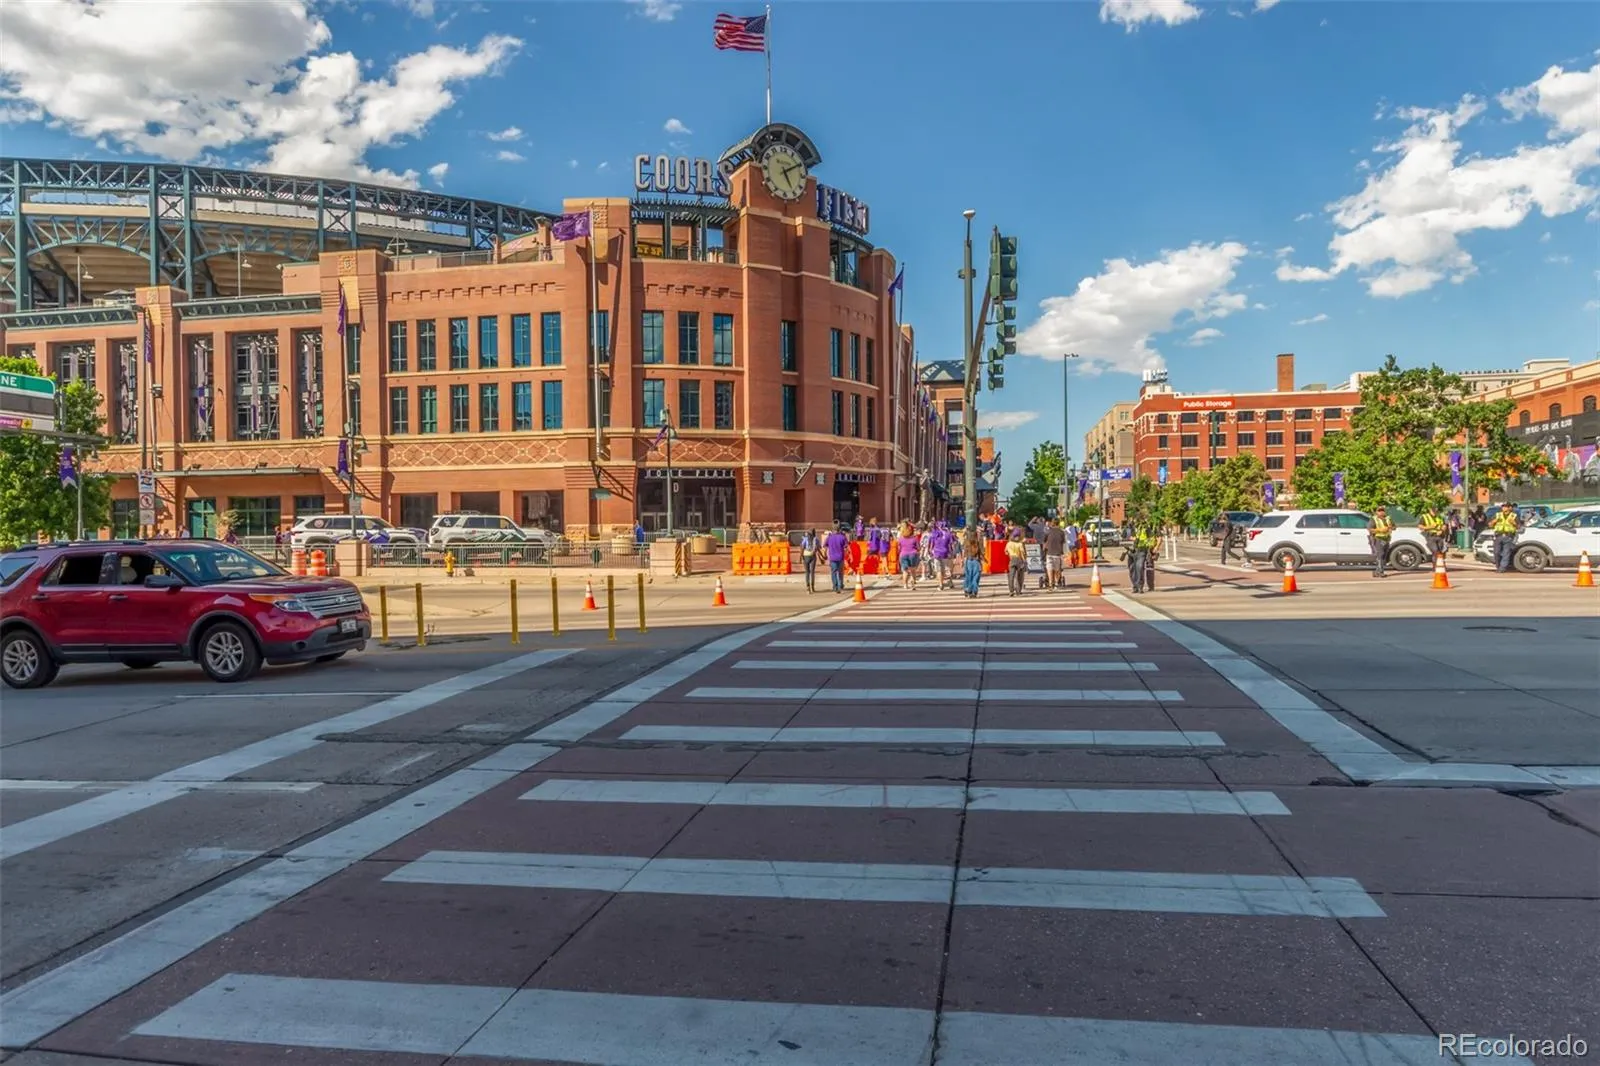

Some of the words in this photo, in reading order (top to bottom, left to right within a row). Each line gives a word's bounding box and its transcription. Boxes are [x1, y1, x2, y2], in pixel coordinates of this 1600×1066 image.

[635, 153, 733, 198] COORS
[1183, 400, 1204, 408] Public
[1205, 400, 1232, 408] Storage
[696, 468, 735, 478] PLATE
